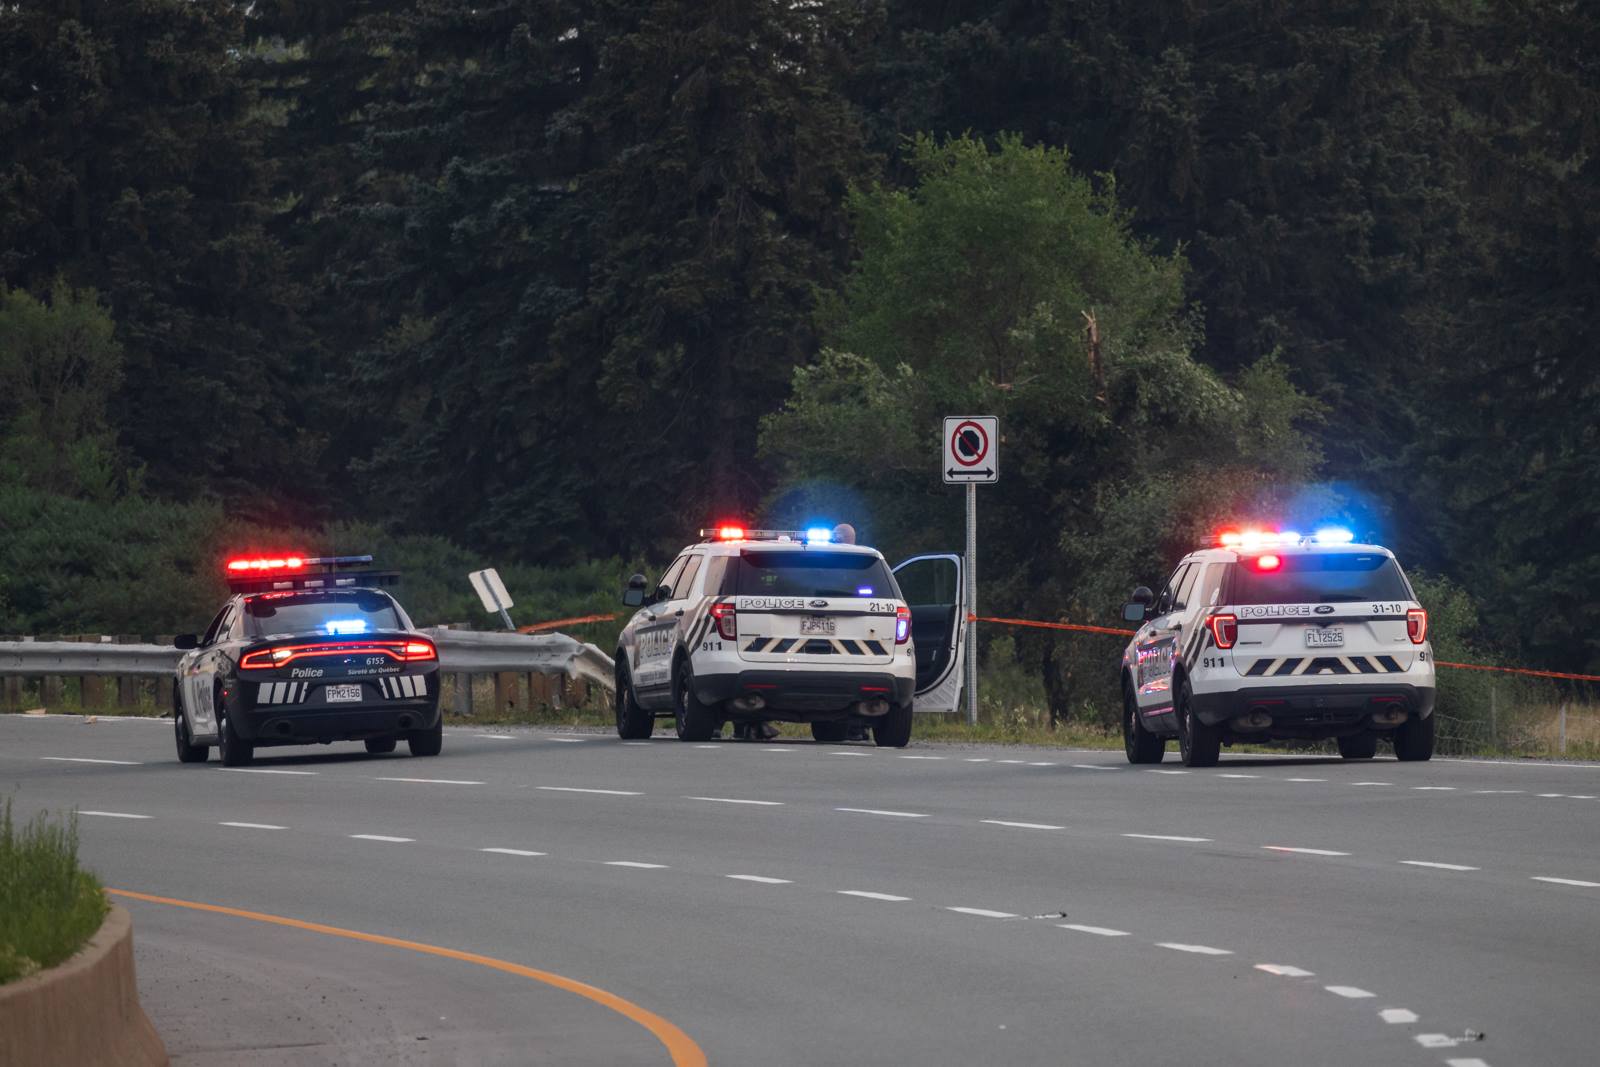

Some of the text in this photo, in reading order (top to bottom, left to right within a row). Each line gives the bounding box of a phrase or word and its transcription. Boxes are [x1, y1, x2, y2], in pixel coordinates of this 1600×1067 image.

[741, 599, 804, 609] POLICE
[870, 602, 895, 613] 21-10
[1372, 604, 1401, 613] 31-10
[1241, 606, 1310, 618] POLICE
[1307, 633, 1343, 643] FLT2525
[703, 641, 722, 651] 911
[366, 656, 385, 665] 6155
[1203, 657, 1224, 668] 911
[291, 667, 324, 678] Police
[327, 688, 360, 699] FPM2156
